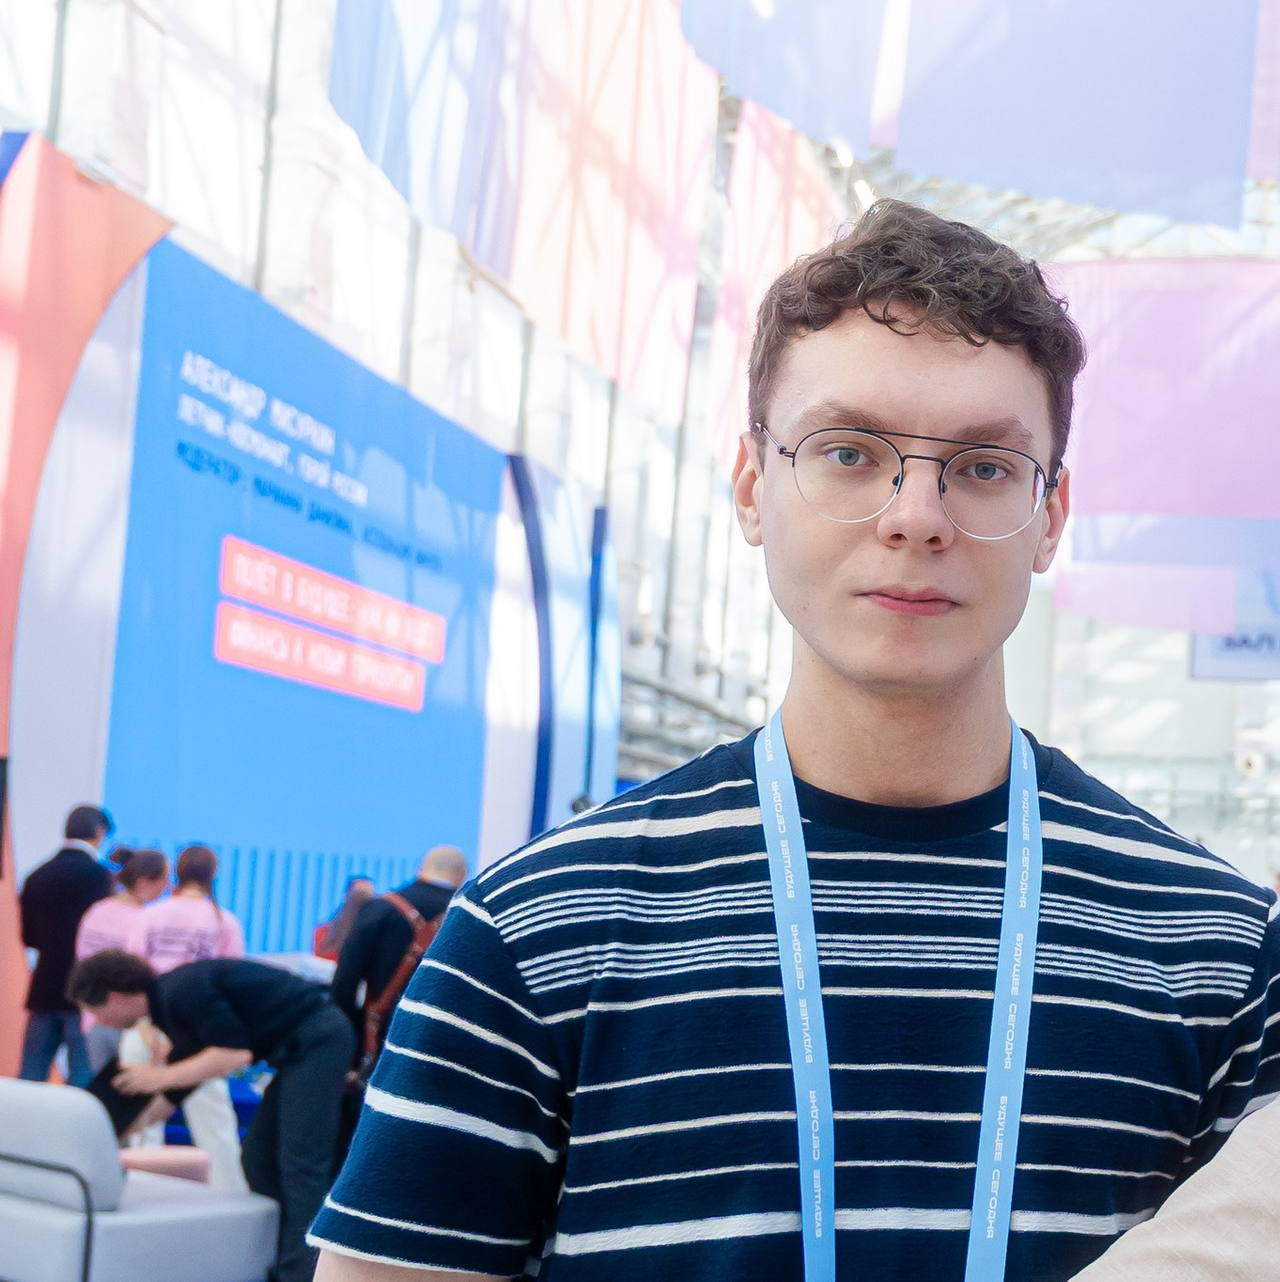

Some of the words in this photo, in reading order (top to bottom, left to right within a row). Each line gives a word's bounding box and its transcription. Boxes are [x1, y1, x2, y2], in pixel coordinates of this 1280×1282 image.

[769, 780, 786, 835] СЕГОДНЯ
[1021, 788, 1030, 842] БУДУЩЕЕ
[781, 838, 796, 899] БУДУЩЕЕ
[1018, 846, 1030, 909] СЕГОДНЯ
[790, 923, 805, 991] СЕГОДНЯ
[1010, 933, 1024, 997] БУДУЩЕЕ
[799, 997, 813, 1064] БУДУЩЕЕ
[1003, 1002, 1018, 1070] СЕГОДНЯ
[808, 1090, 821, 1161] СЕГОДНЯ
[993, 1095, 1008, 1162] БУДУЩЕЕ
[813, 1169, 822, 1239] БУДУЩЕЕ
[986, 1168, 1001, 1239] СЕГОДНЯ
